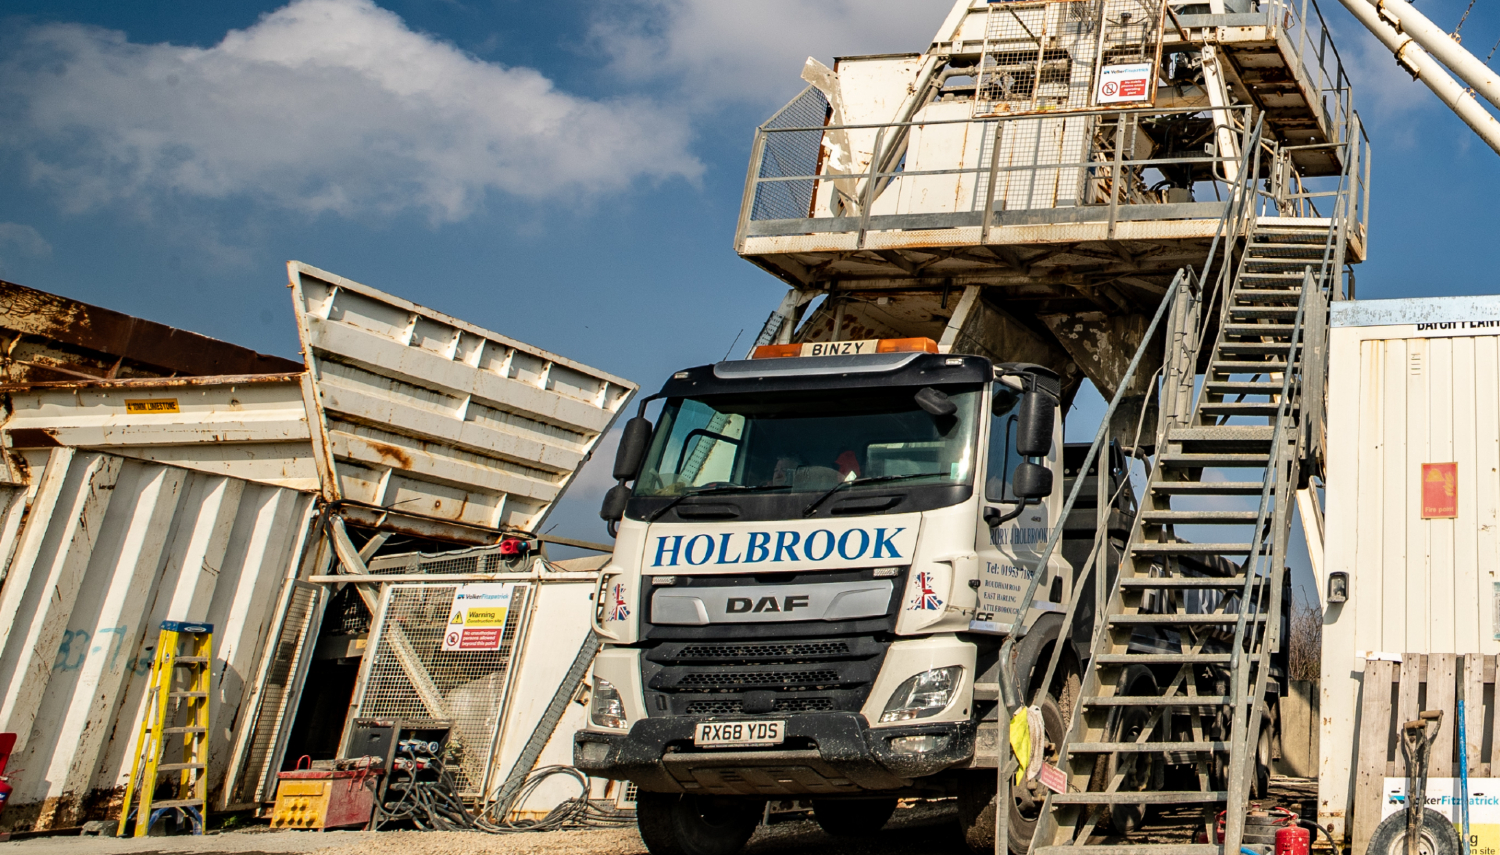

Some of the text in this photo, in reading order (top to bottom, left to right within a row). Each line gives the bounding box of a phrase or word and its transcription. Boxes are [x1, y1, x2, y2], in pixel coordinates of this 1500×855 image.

[811, 342, 864, 356] BINZY
[990, 528, 1009, 545] RORY
[650, 527, 907, 568] HOLBROOK
[986, 561, 999, 575] Tel:
[1001, 564, 1018, 578] 01953
[983, 591, 996, 600] EAST
[726, 595, 809, 614] DAF
[468, 611, 495, 619] Warning
[701, 723, 778, 741] RX68 YDS
